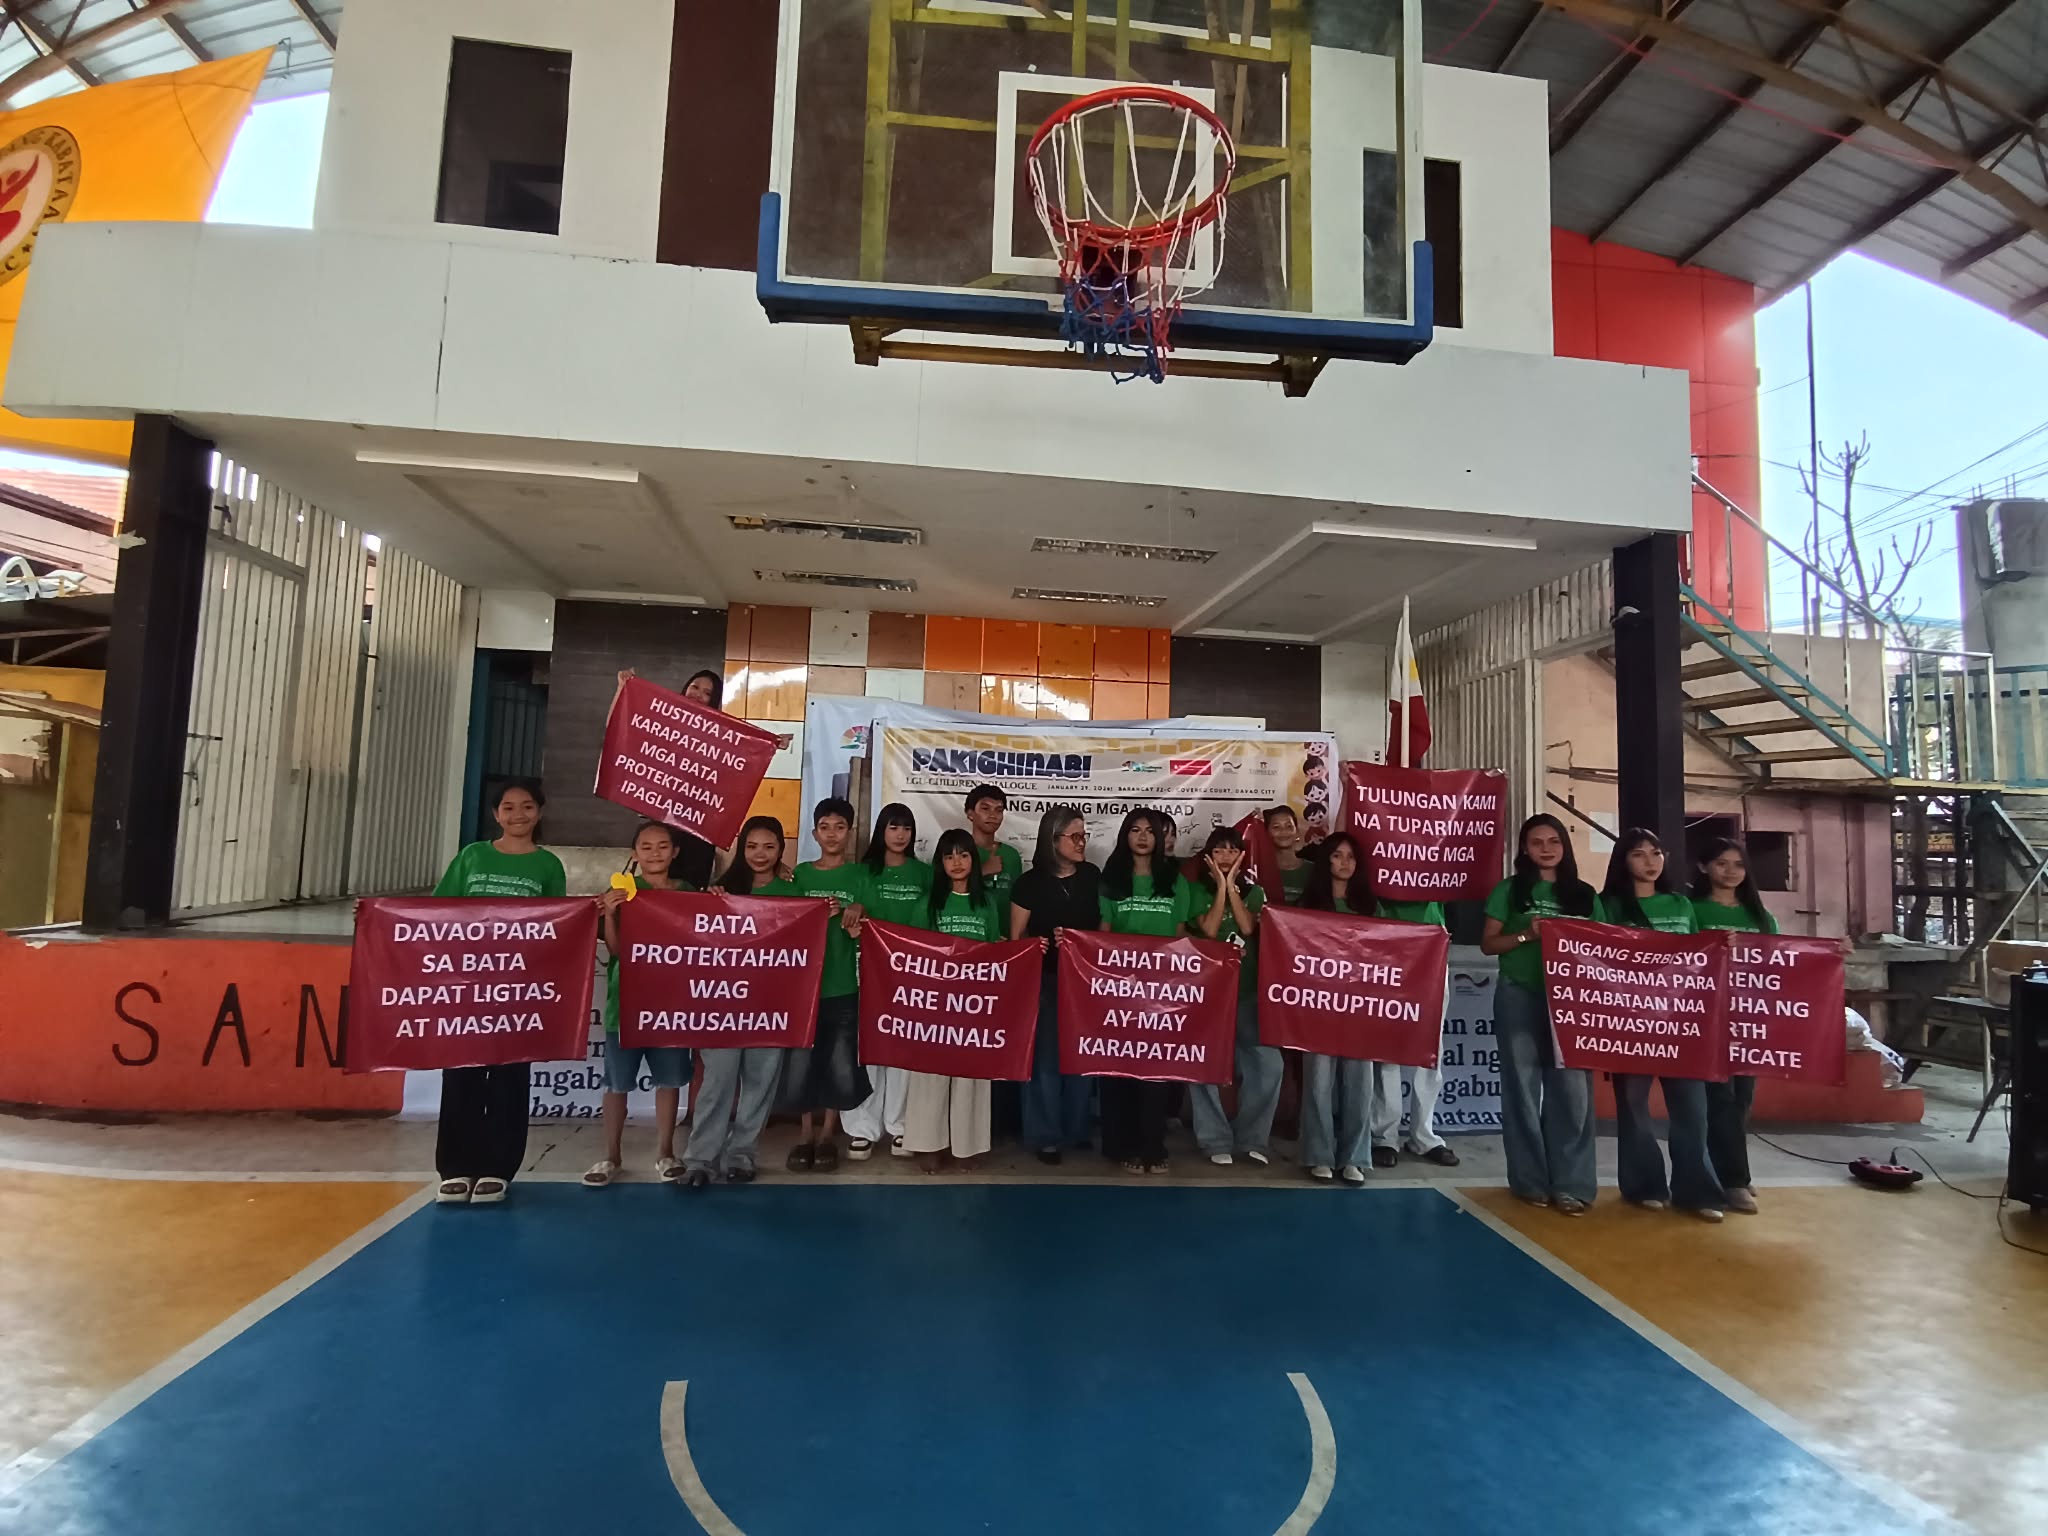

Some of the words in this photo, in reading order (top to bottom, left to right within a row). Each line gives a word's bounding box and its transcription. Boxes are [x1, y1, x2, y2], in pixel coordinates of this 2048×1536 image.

[40, 130, 74, 222] KABATAA
[649, 697, 720, 738] HUSTISYA
[721, 730, 745, 747] AT
[630, 713, 721, 760] KARAPATAN
[721, 753, 747, 771] NG
[639, 741, 676, 767] MGA
[679, 757, 719, 784] BATA
[910, 747, 1093, 779] PAKIGHINABI
[614, 754, 726, 813] PROTEKTAHAN,
[620, 779, 706, 825] IPAGLABAN
[1096, 803, 1129, 815] MGA
[1356, 785, 1457, 810] TULUNGAN
[1463, 794, 1496, 811] KAMI
[1354, 811, 1381, 831] NA
[1386, 815, 1464, 837] TUPARIN
[1465, 820, 1495, 836] ANG
[1372, 841, 1440, 862] AMING
[1443, 846, 1475, 862] MGA
[1377, 868, 1468, 888] PANGARAP
[393, 922, 485, 942] DAVAO
[492, 921, 557, 940] PARA
[694, 913, 757, 935] BATA
[421, 954, 454, 973] SA
[462, 952, 526, 972] BATA
[630, 943, 808, 967] PROTEKTAHAN
[1097, 949, 1166, 971] LAHAT
[1170, 954, 1202, 973] NG
[1558, 938, 1630, 961] DUGANG
[1631, 951, 1708, 968] SERBISYO
[1732, 947, 1763, 964] LIS
[1768, 950, 1800, 967] AT
[890, 952, 1008, 982] CHILDREN
[1292, 954, 1352, 980] STOP
[1358, 962, 1403, 987] THE
[1546, 961, 1571, 977] UG
[1575, 964, 1668, 989] PROGRAMA
[1672, 974, 1716, 991] PARA
[381, 985, 466, 1006] DAPAT
[473, 982, 562, 1003] LIGTAS,
[689, 979, 749, 999] WAG
[892, 985, 939, 1011] ARE
[945, 993, 999, 1015] NOT
[1090, 977, 1205, 1004] KABATAAN
[1552, 985, 1574, 1001] SA
[1579, 988, 1668, 1012] KABATAAN
[1673, 998, 1706, 1014] NAA
[1267, 983, 1421, 1022] CORRUPTION
[1776, 1000, 1810, 1018] NG
[396, 1018, 430, 1037] AT
[437, 1012, 544, 1036] MASAYA
[638, 1011, 788, 1031] PARUSAHAN
[877, 1014, 1006, 1049] CRIMINALS
[1103, 1009, 1133, 1028] AY
[1137, 1011, 1187, 1032] MAY
[1555, 1009, 1576, 1026] SA
[1579, 1012, 1679, 1037] SITWASYON
[1681, 1022, 1701, 1038] SA
[1078, 1036, 1206, 1063] KARAPATAN
[1575, 1035, 1679, 1060] KADALANAN
[1729, 1045, 1803, 1069] FICATE
